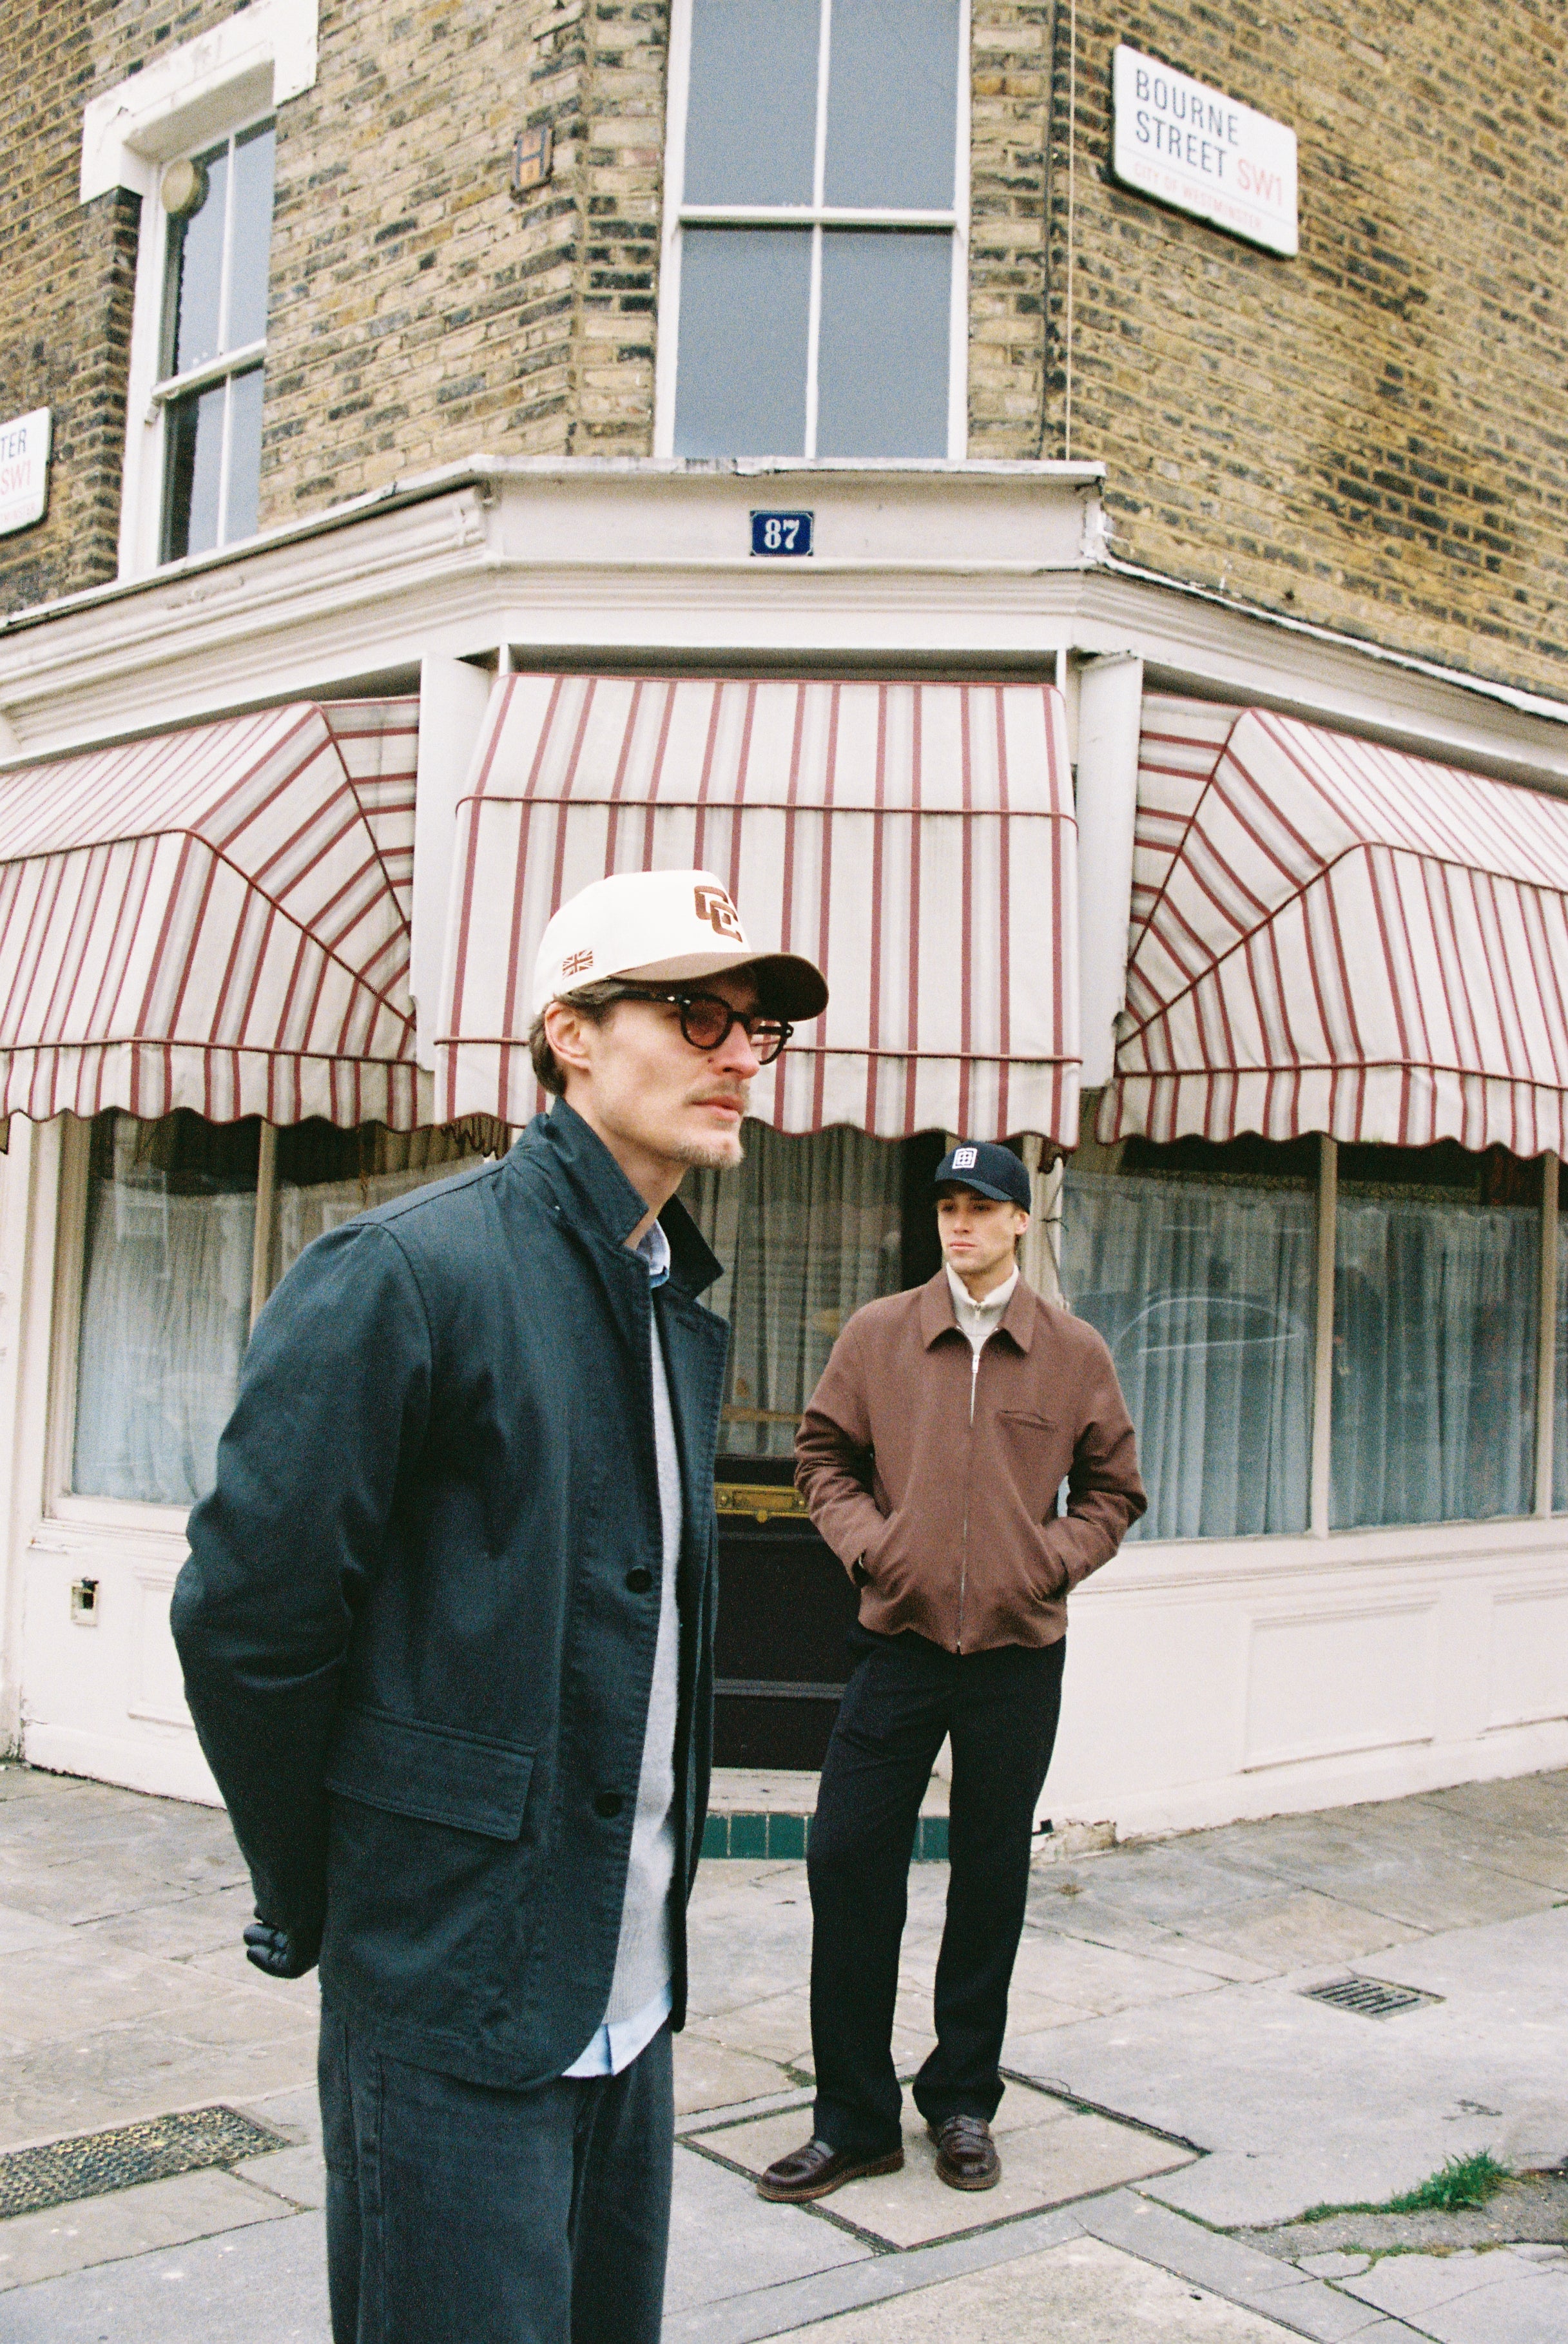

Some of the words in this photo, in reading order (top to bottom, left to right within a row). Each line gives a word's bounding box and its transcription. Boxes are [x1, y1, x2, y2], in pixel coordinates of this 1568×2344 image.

[1136, 68, 1239, 146] BOURNE
[515, 127, 547, 188] H
[1136, 110, 1228, 178] STREET
[1237, 158, 1282, 207] SW1
[0, 459, 32, 495] SW1
[764, 518, 800, 550] 87
